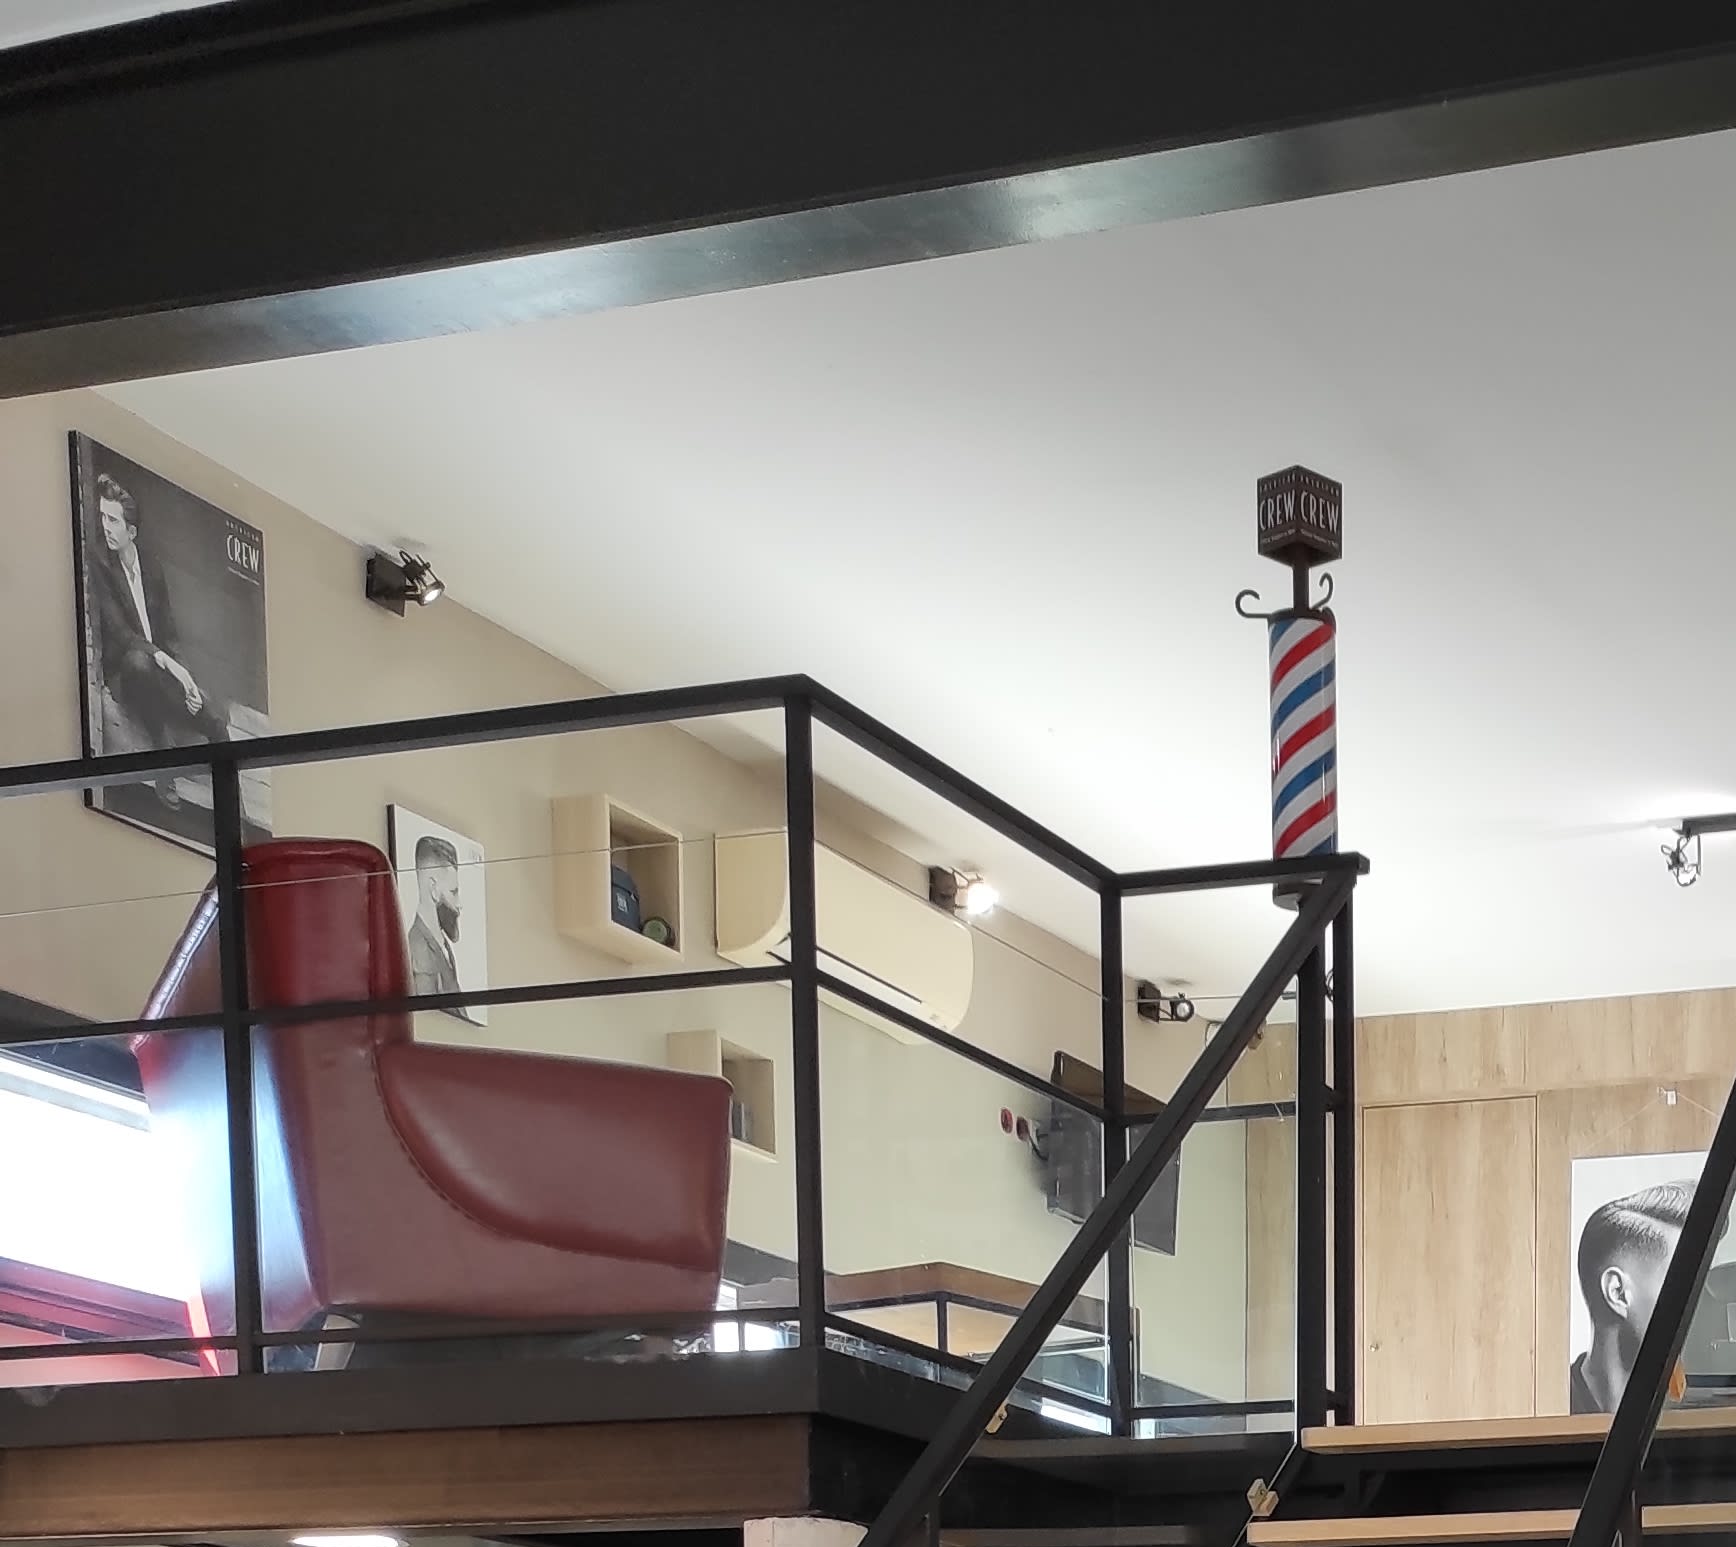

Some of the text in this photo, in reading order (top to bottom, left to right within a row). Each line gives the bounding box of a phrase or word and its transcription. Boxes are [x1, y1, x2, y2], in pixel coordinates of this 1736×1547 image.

[1260, 489, 1296, 531] CREW
[1300, 490, 1340, 534] CREW
[226, 534, 260, 574] CREW
